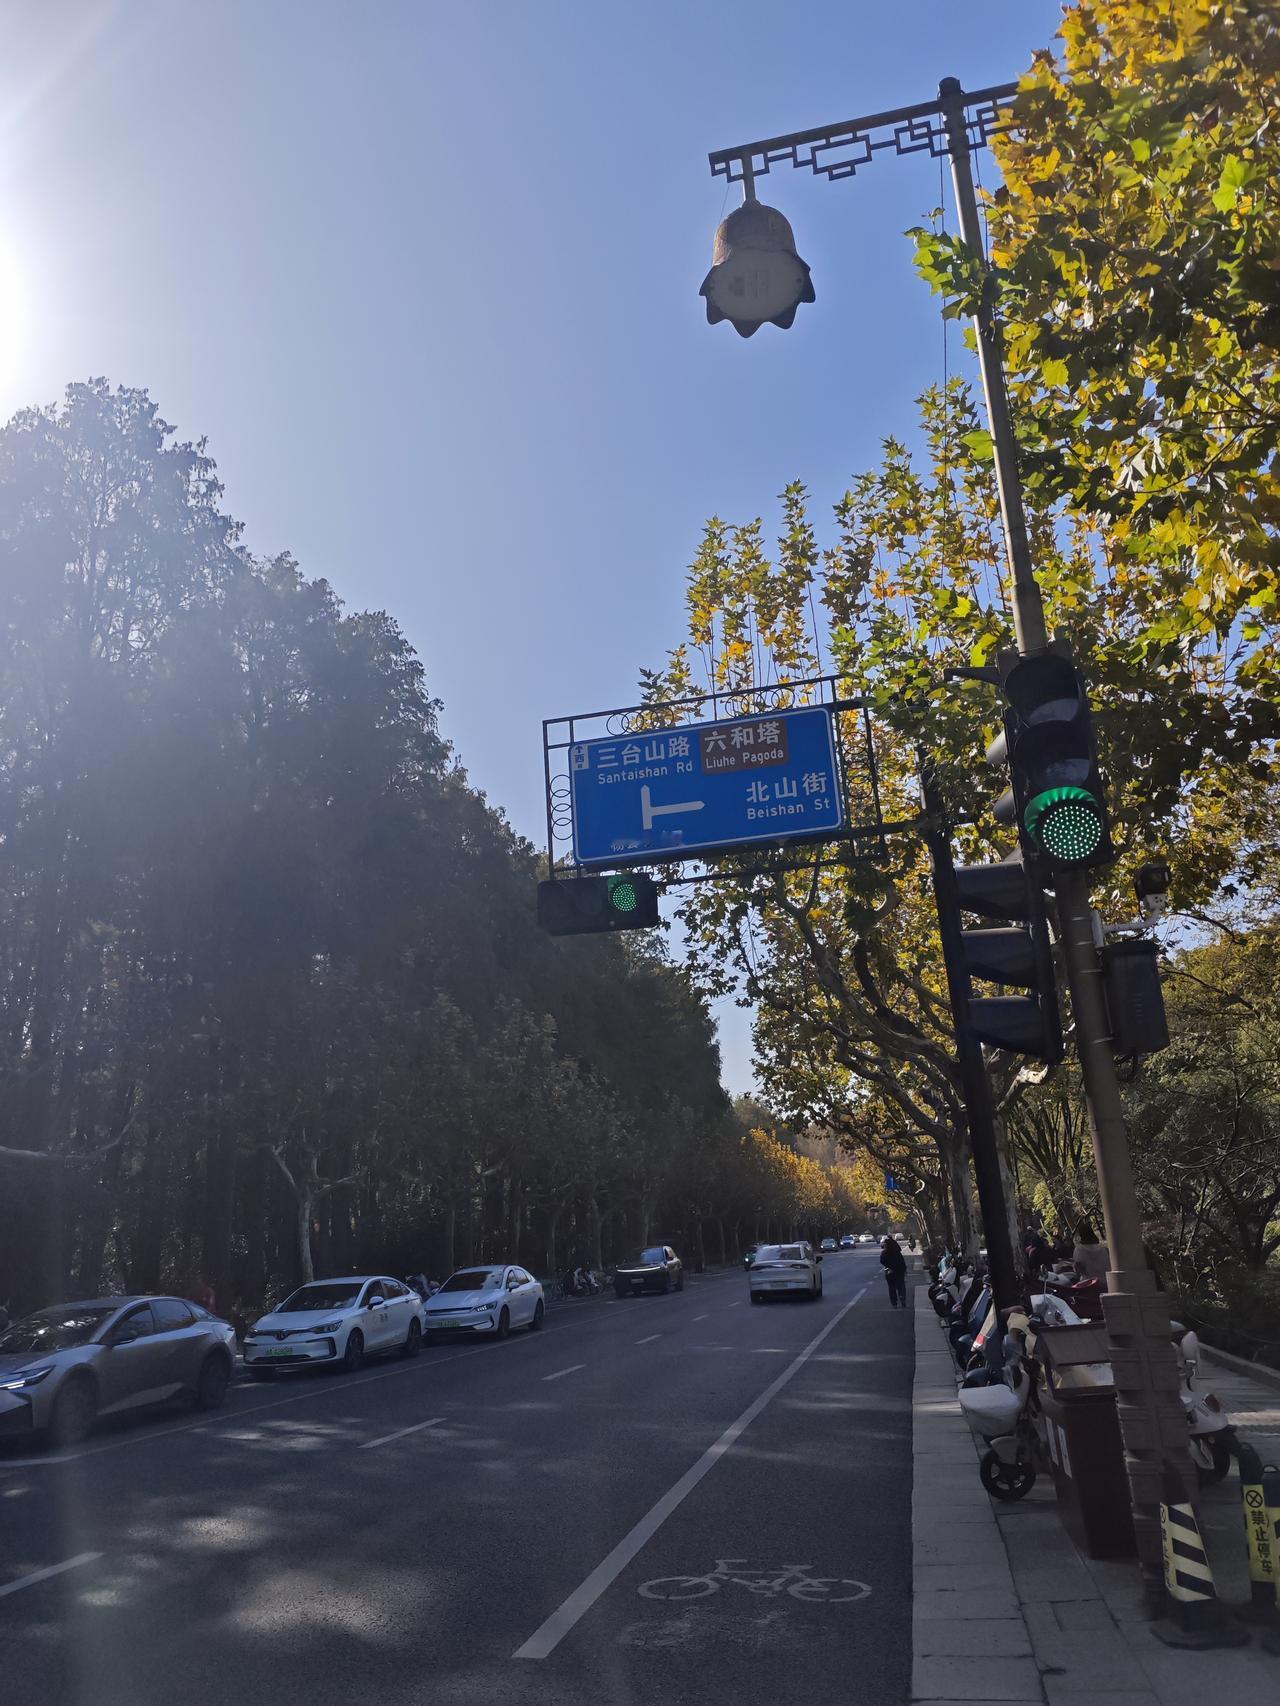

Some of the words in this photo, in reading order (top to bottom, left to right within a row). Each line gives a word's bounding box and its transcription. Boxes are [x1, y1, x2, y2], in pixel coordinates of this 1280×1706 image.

[597, 736, 690, 768] 三台山路
[704, 721, 781, 753] 六和塔
[598, 766, 668, 784] Santaishan
[676, 760, 693, 773] Rd
[706, 755, 736, 769] Liuhe
[742, 748, 784, 764] Pagoda
[746, 772, 827, 803] 北山街
[747, 804, 804, 820] Beishan
[814, 798, 830, 811] St
[1251, 1510, 1273, 1575] 禁止停车
